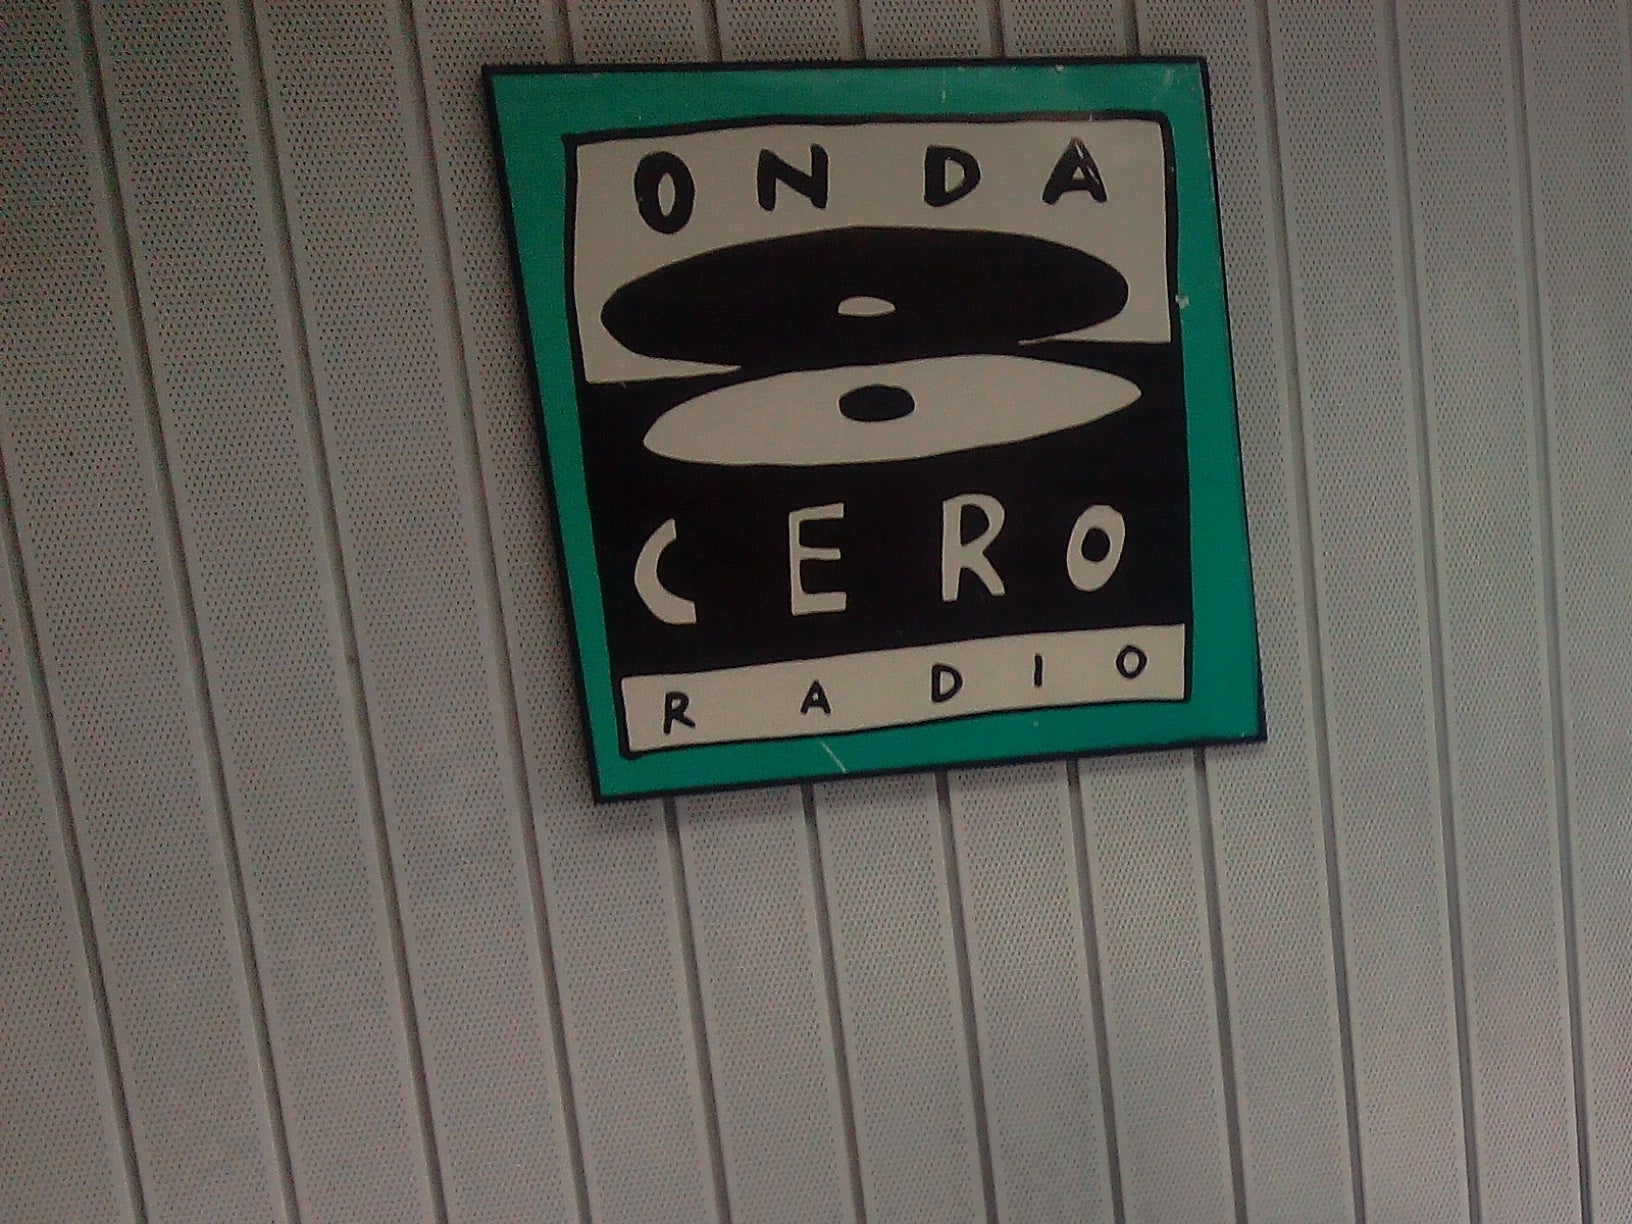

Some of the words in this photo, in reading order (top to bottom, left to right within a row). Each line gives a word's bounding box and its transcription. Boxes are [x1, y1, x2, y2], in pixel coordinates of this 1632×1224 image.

[634, 136, 1108, 234] ONDA
[633, 492, 1126, 625] CERO
[662, 645, 1147, 734] RADIO
